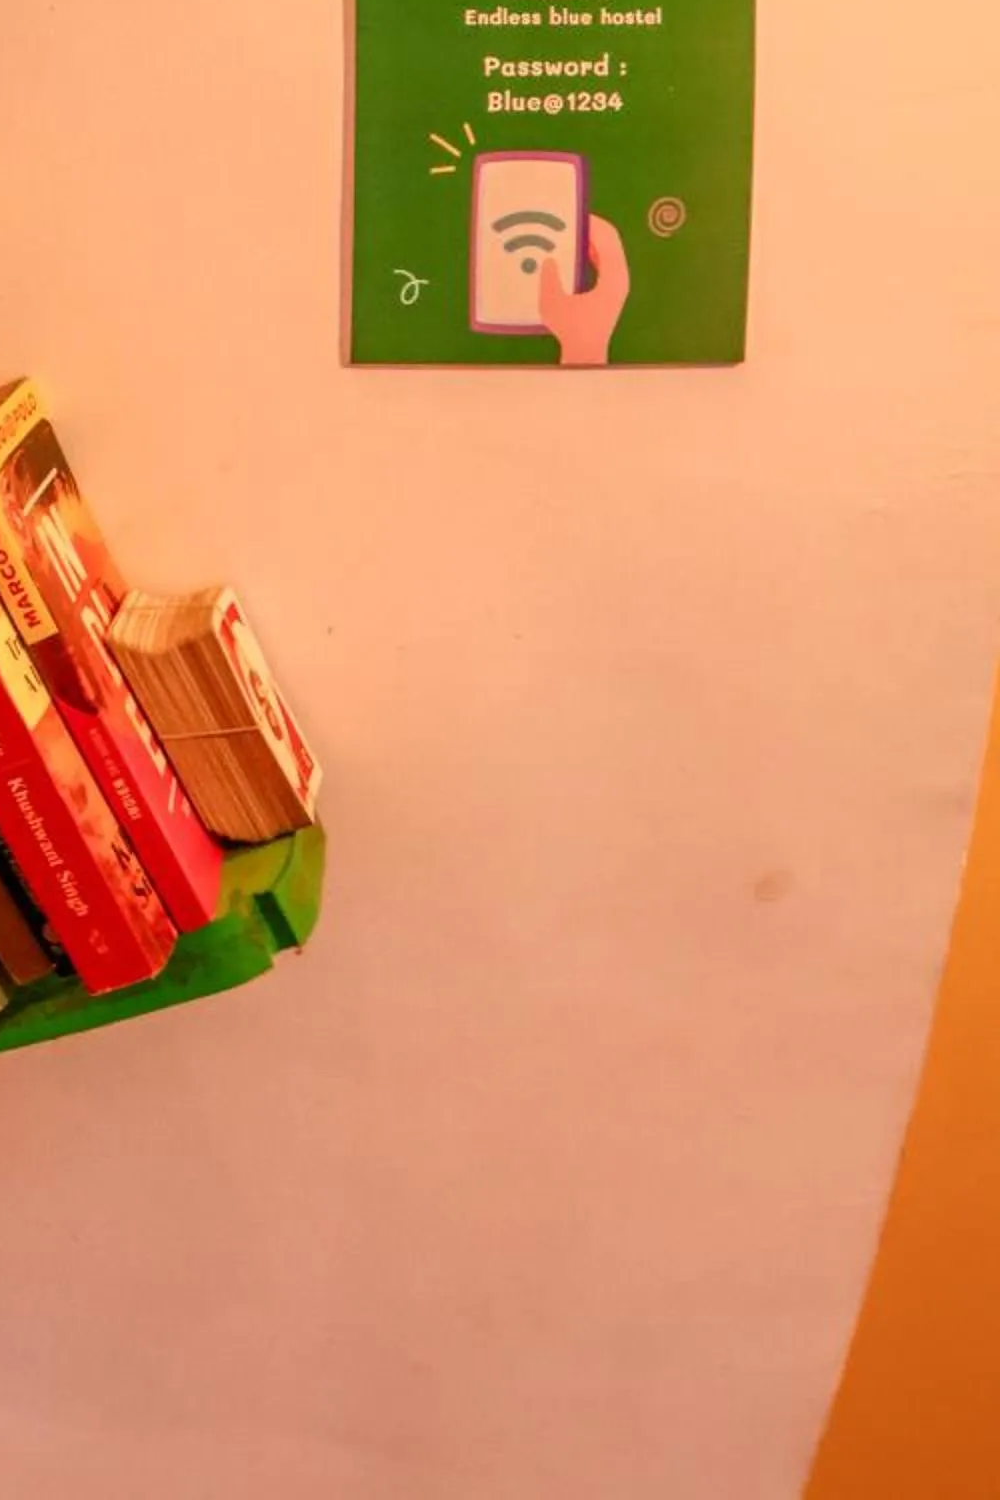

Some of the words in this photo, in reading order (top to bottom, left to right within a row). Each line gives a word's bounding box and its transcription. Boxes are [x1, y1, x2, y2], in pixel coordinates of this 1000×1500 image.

[464, 9, 542, 27] Endless
[548, 8, 593, 27] blue
[600, 8, 663, 27] hostel
[483, 55, 610, 78] Password
[487, 91, 624, 115] Blue@1234
[7, 776, 65, 868] Khushwant
[55, 868, 90, 918] Singh
